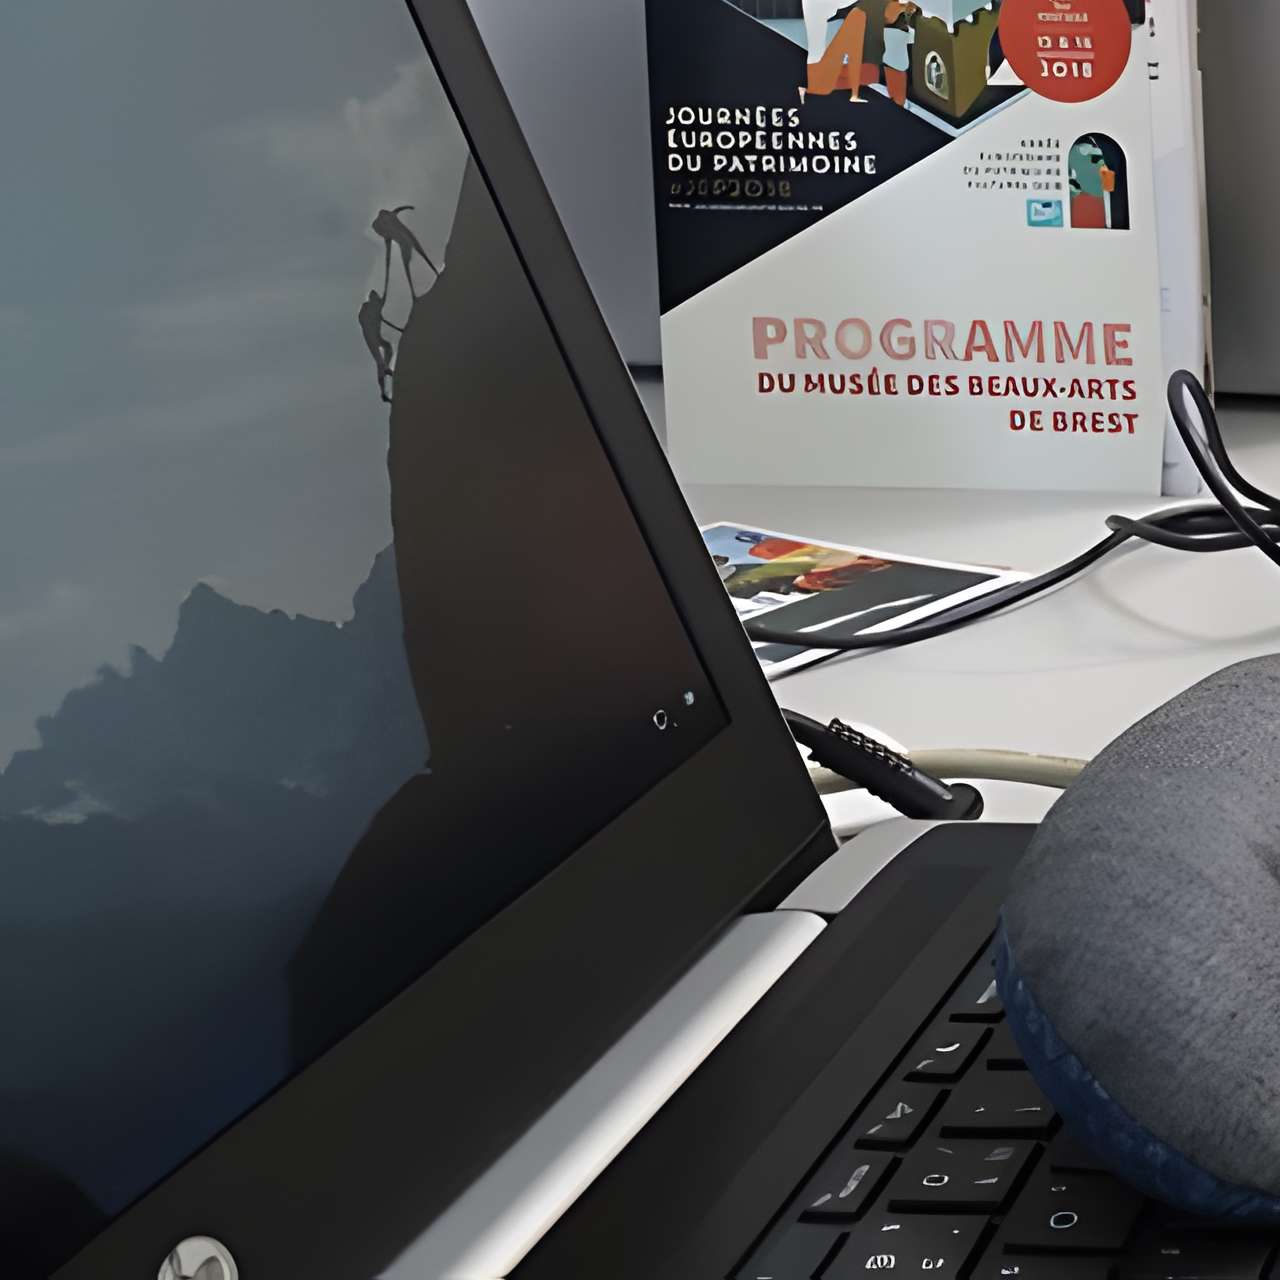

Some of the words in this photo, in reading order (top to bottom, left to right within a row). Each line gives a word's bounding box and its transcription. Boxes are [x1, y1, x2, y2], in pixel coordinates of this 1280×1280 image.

[667, 153, 702, 172] DU
[713, 154, 877, 175] PATRIMOINE
[752, 317, 1134, 366] PROGRAMME
[758, 371, 796, 395] DU
[907, 374, 961, 396] DES
[968, 375, 1138, 401] BEAUX-ARTS
[1009, 410, 1045, 432] DE
[1052, 411, 1139, 435] BREST
